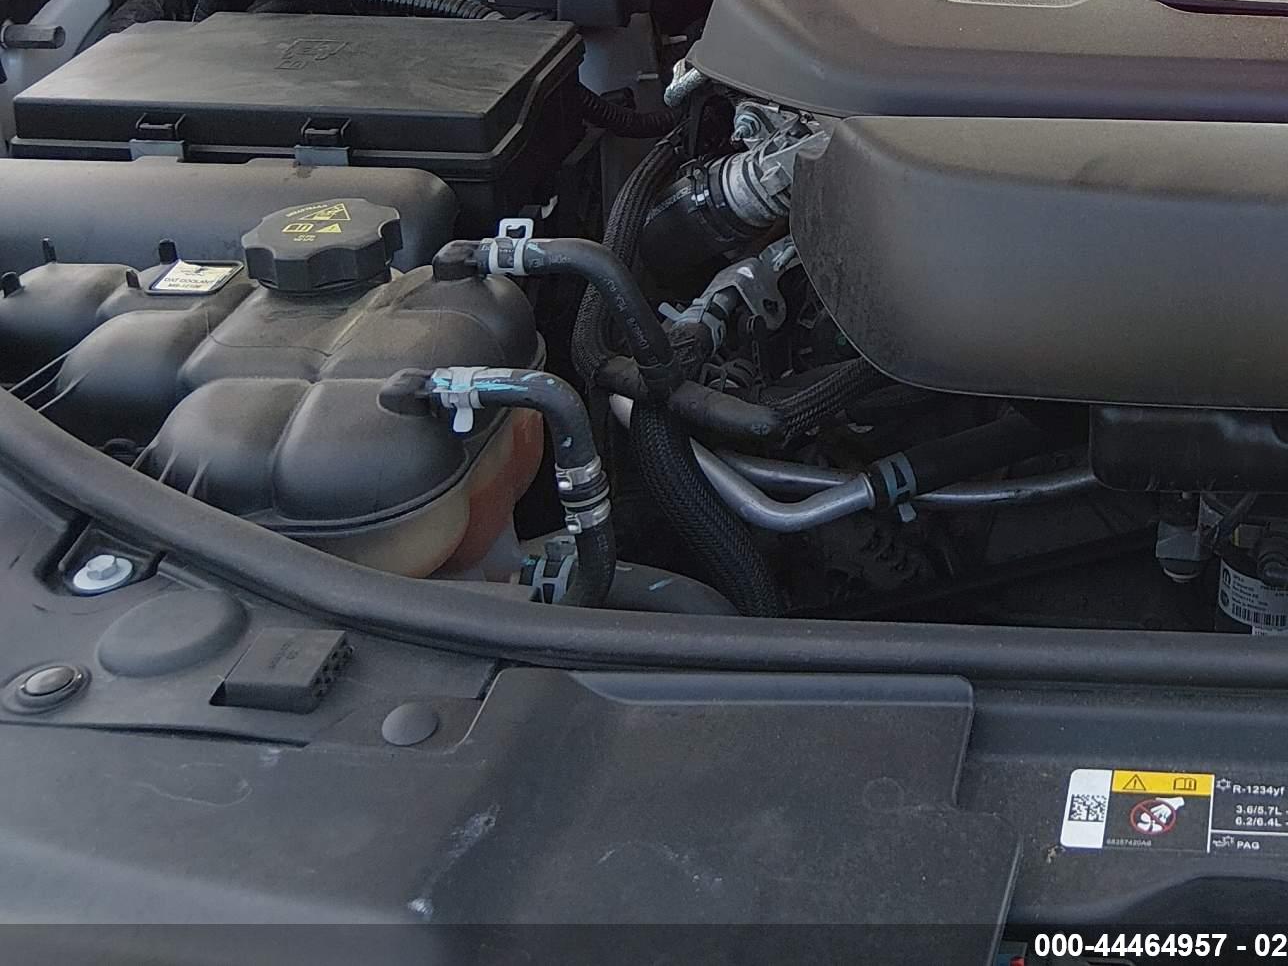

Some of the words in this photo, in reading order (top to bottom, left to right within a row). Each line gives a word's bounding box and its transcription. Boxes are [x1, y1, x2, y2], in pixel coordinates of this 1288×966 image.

[1233, 784, 1285, 797] R-1234yf
[1235, 804, 1282, 816] 3.6/5.7L
[1235, 816, 1282, 827] 6.2/6.4L
[1237, 840, 1260, 850] PAG
